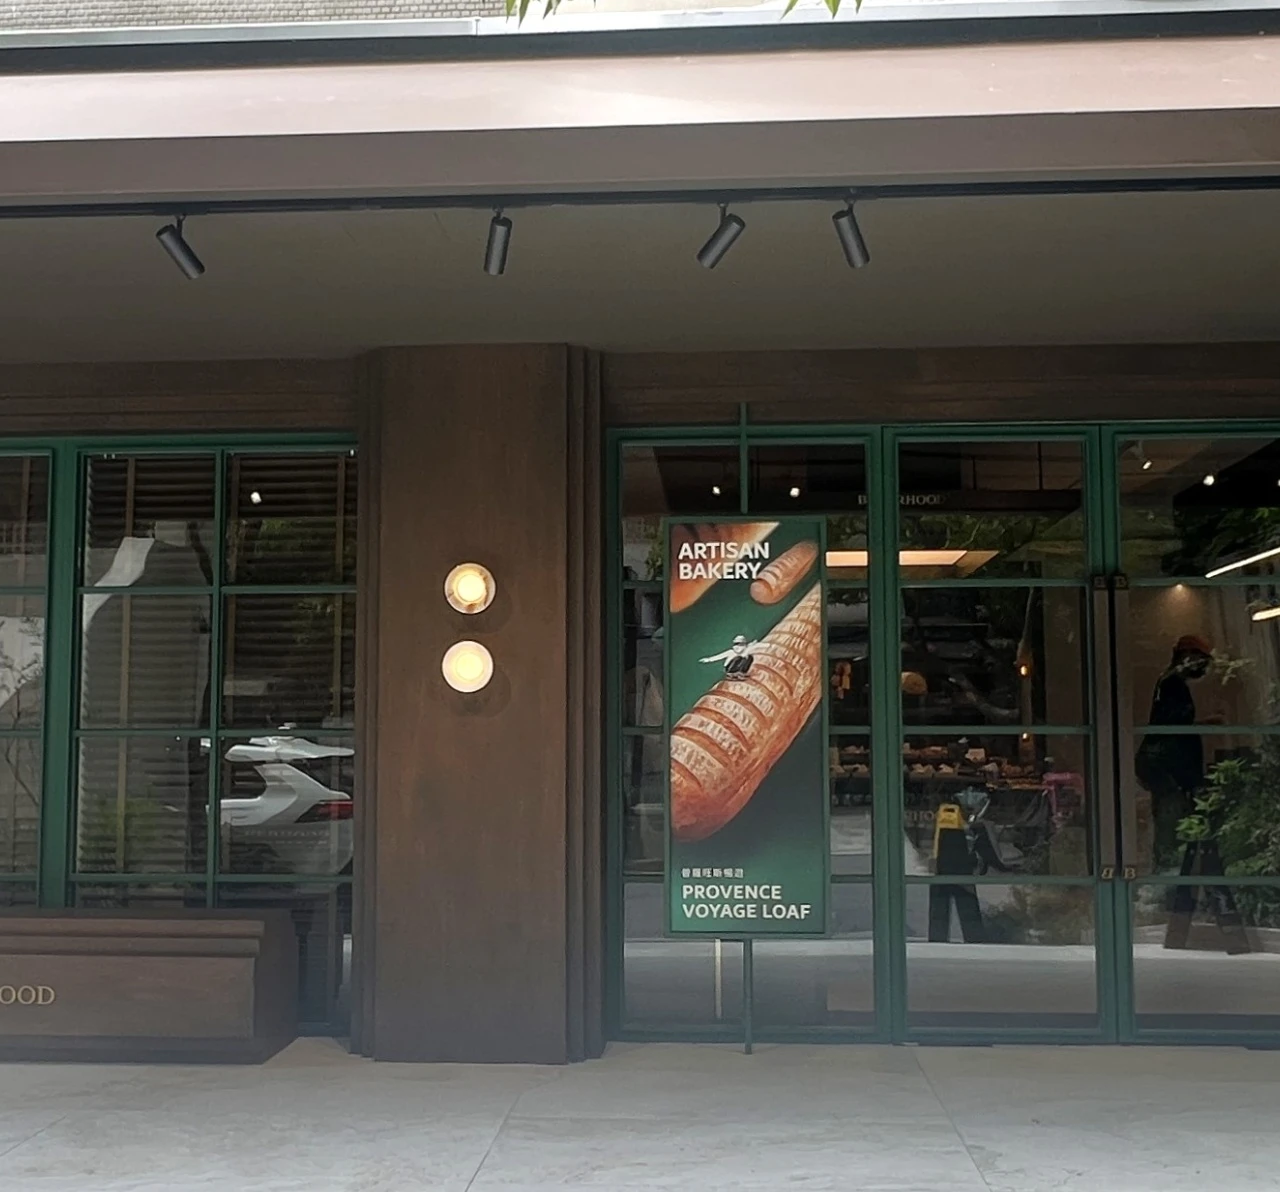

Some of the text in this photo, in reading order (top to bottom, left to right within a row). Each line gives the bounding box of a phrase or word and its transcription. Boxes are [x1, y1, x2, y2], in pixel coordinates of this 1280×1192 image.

[678, 542, 770, 560] ARTISAN
[679, 562, 761, 580] BAKERY
[682, 885, 782, 900] PROVENCE
[682, 904, 811, 919] VOYAGE LOAF
